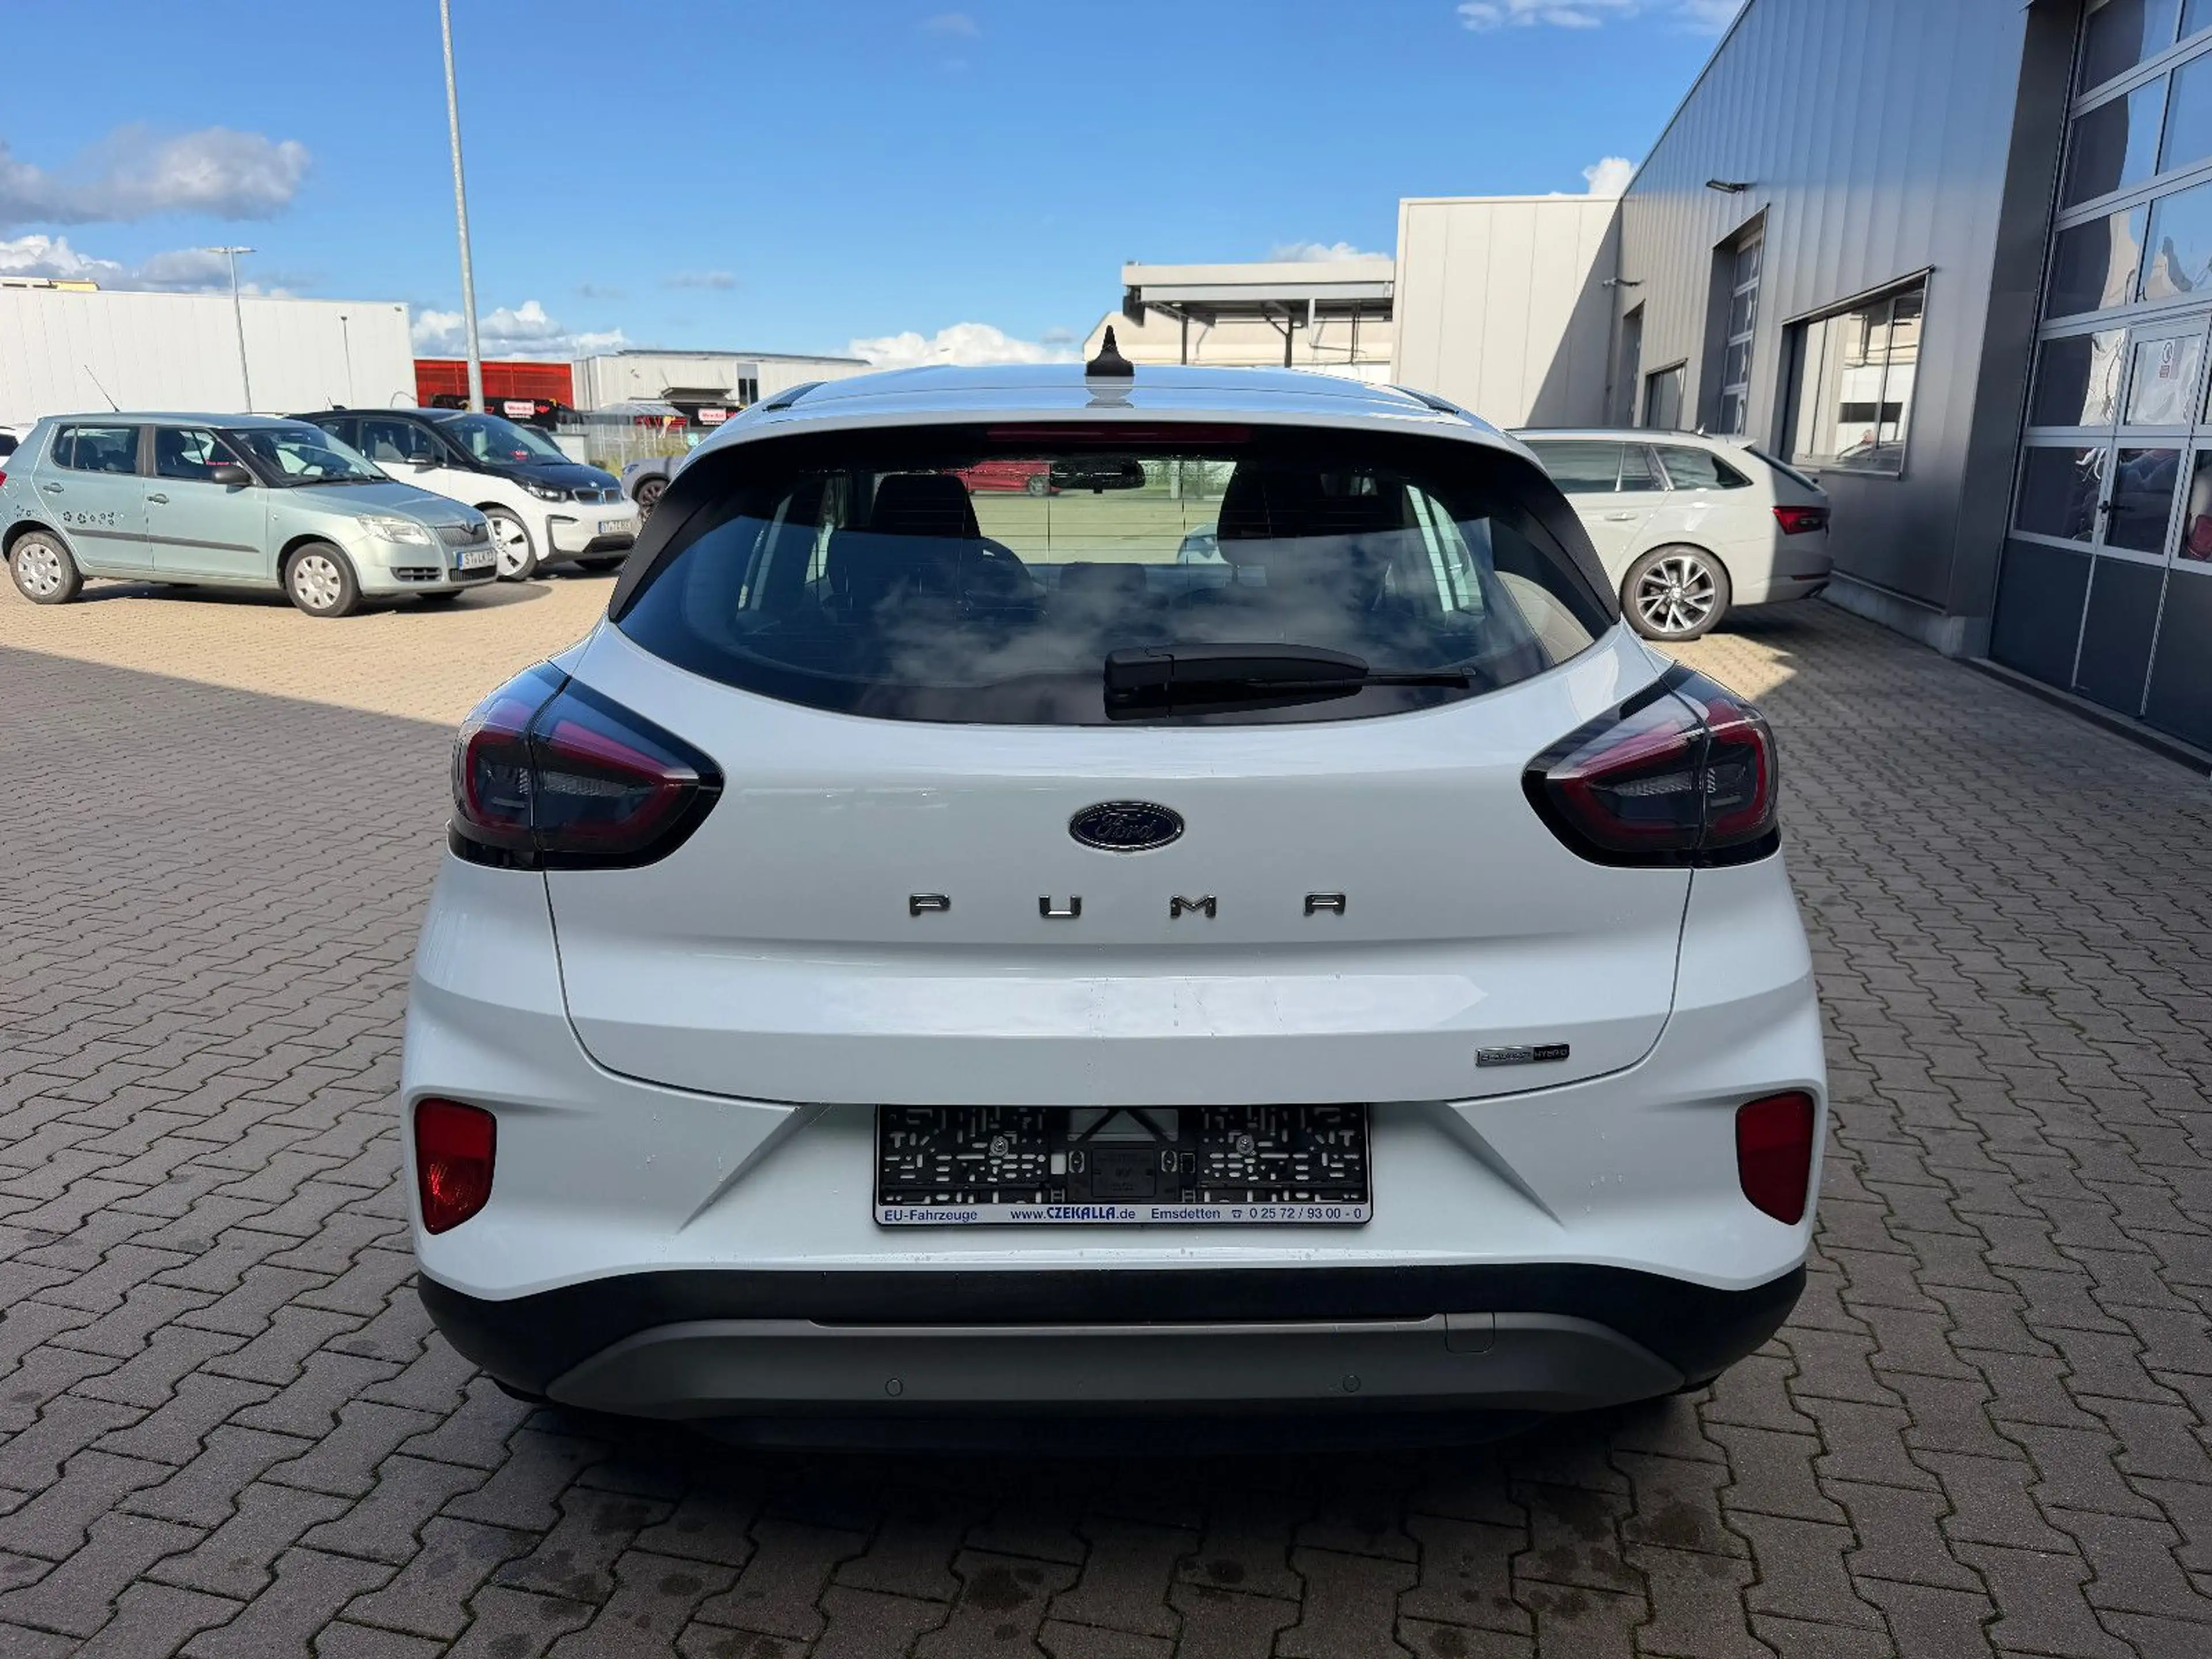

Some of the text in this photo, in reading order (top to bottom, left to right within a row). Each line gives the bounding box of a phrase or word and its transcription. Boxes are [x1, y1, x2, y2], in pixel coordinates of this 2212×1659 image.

[910, 892, 1346, 918] PUMA
[884, 1209, 978, 1223] EU-Fahrzeuge
[1010, 1207, 1135, 1220] www.CZEKALLA.de
[1152, 1208, 1220, 1219] Emsdetten
[1261, 1207, 1275, 1219] 25
[1280, 1207, 1295, 1219] 72
[1307, 1207, 1323, 1219] 93
[1325, 1207, 1340, 1219] 00
